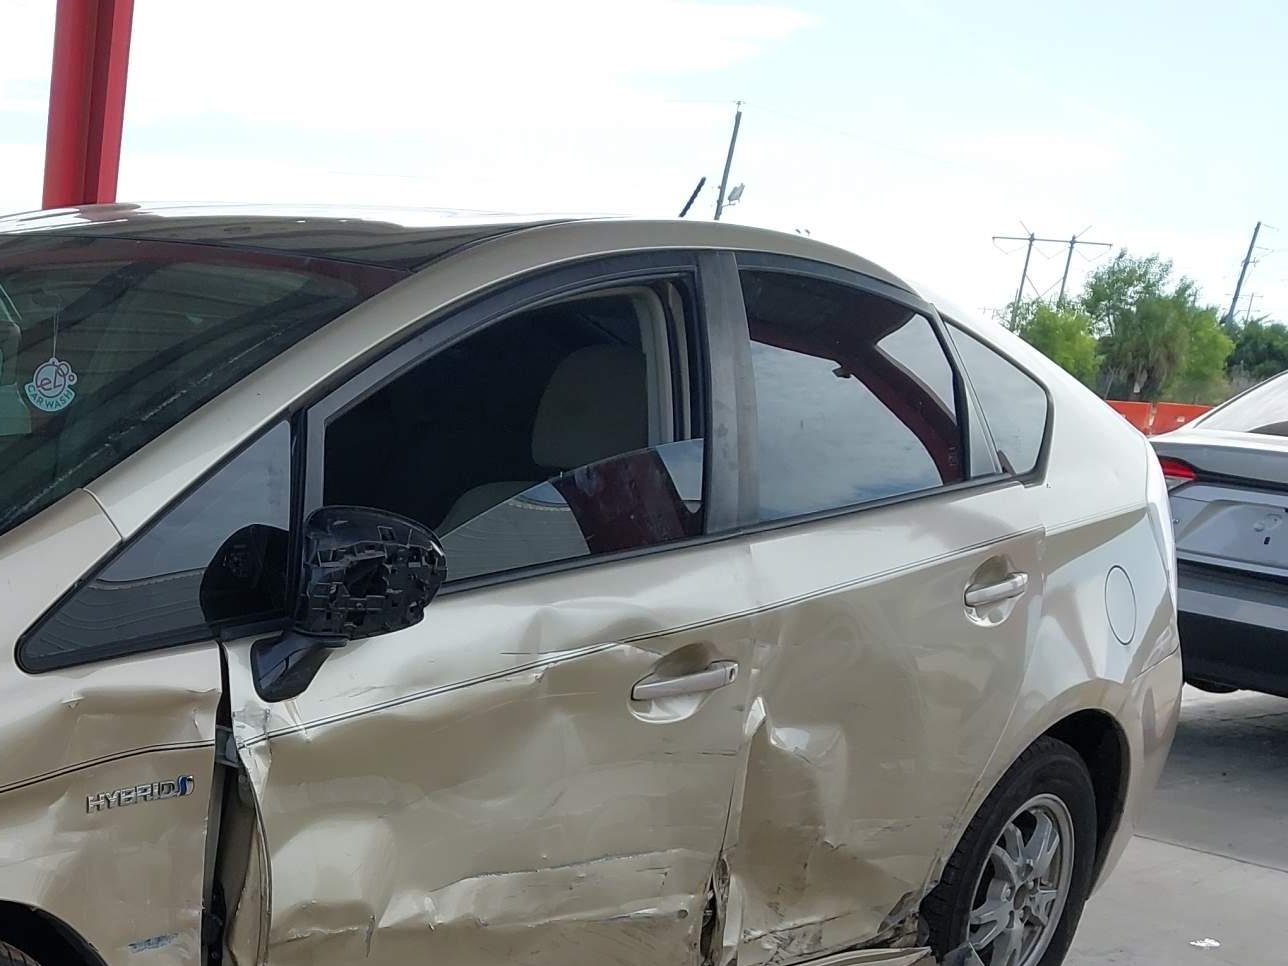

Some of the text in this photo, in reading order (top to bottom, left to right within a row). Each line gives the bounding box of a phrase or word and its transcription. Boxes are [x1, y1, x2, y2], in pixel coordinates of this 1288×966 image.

[27, 384, 73, 409] CAR WASH
[86, 780, 176, 814] HYBRID
